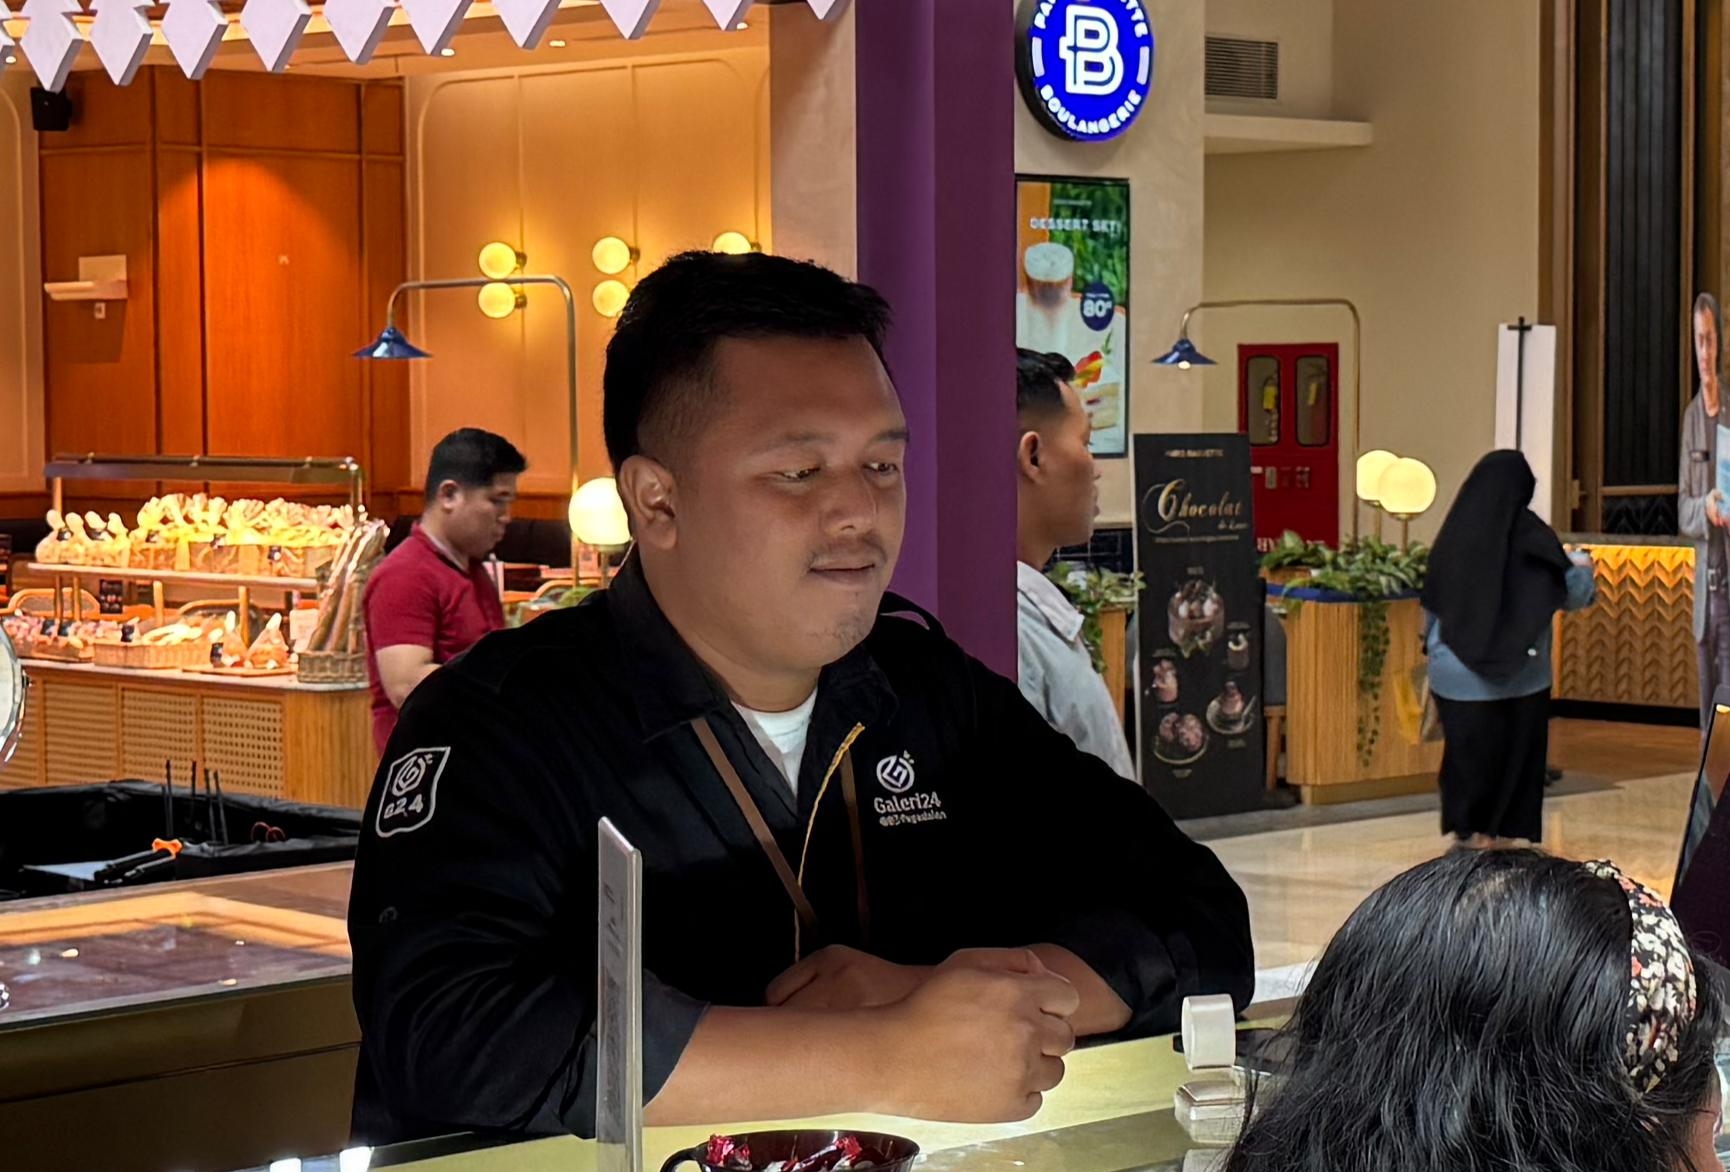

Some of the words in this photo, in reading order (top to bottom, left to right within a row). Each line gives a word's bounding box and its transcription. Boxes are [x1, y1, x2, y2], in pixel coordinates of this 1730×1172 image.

[1040, 84, 1141, 134] BOULANGERIE
[1030, 217, 1089, 230] DESSERT
[873, 792, 942, 814] Galeri24
